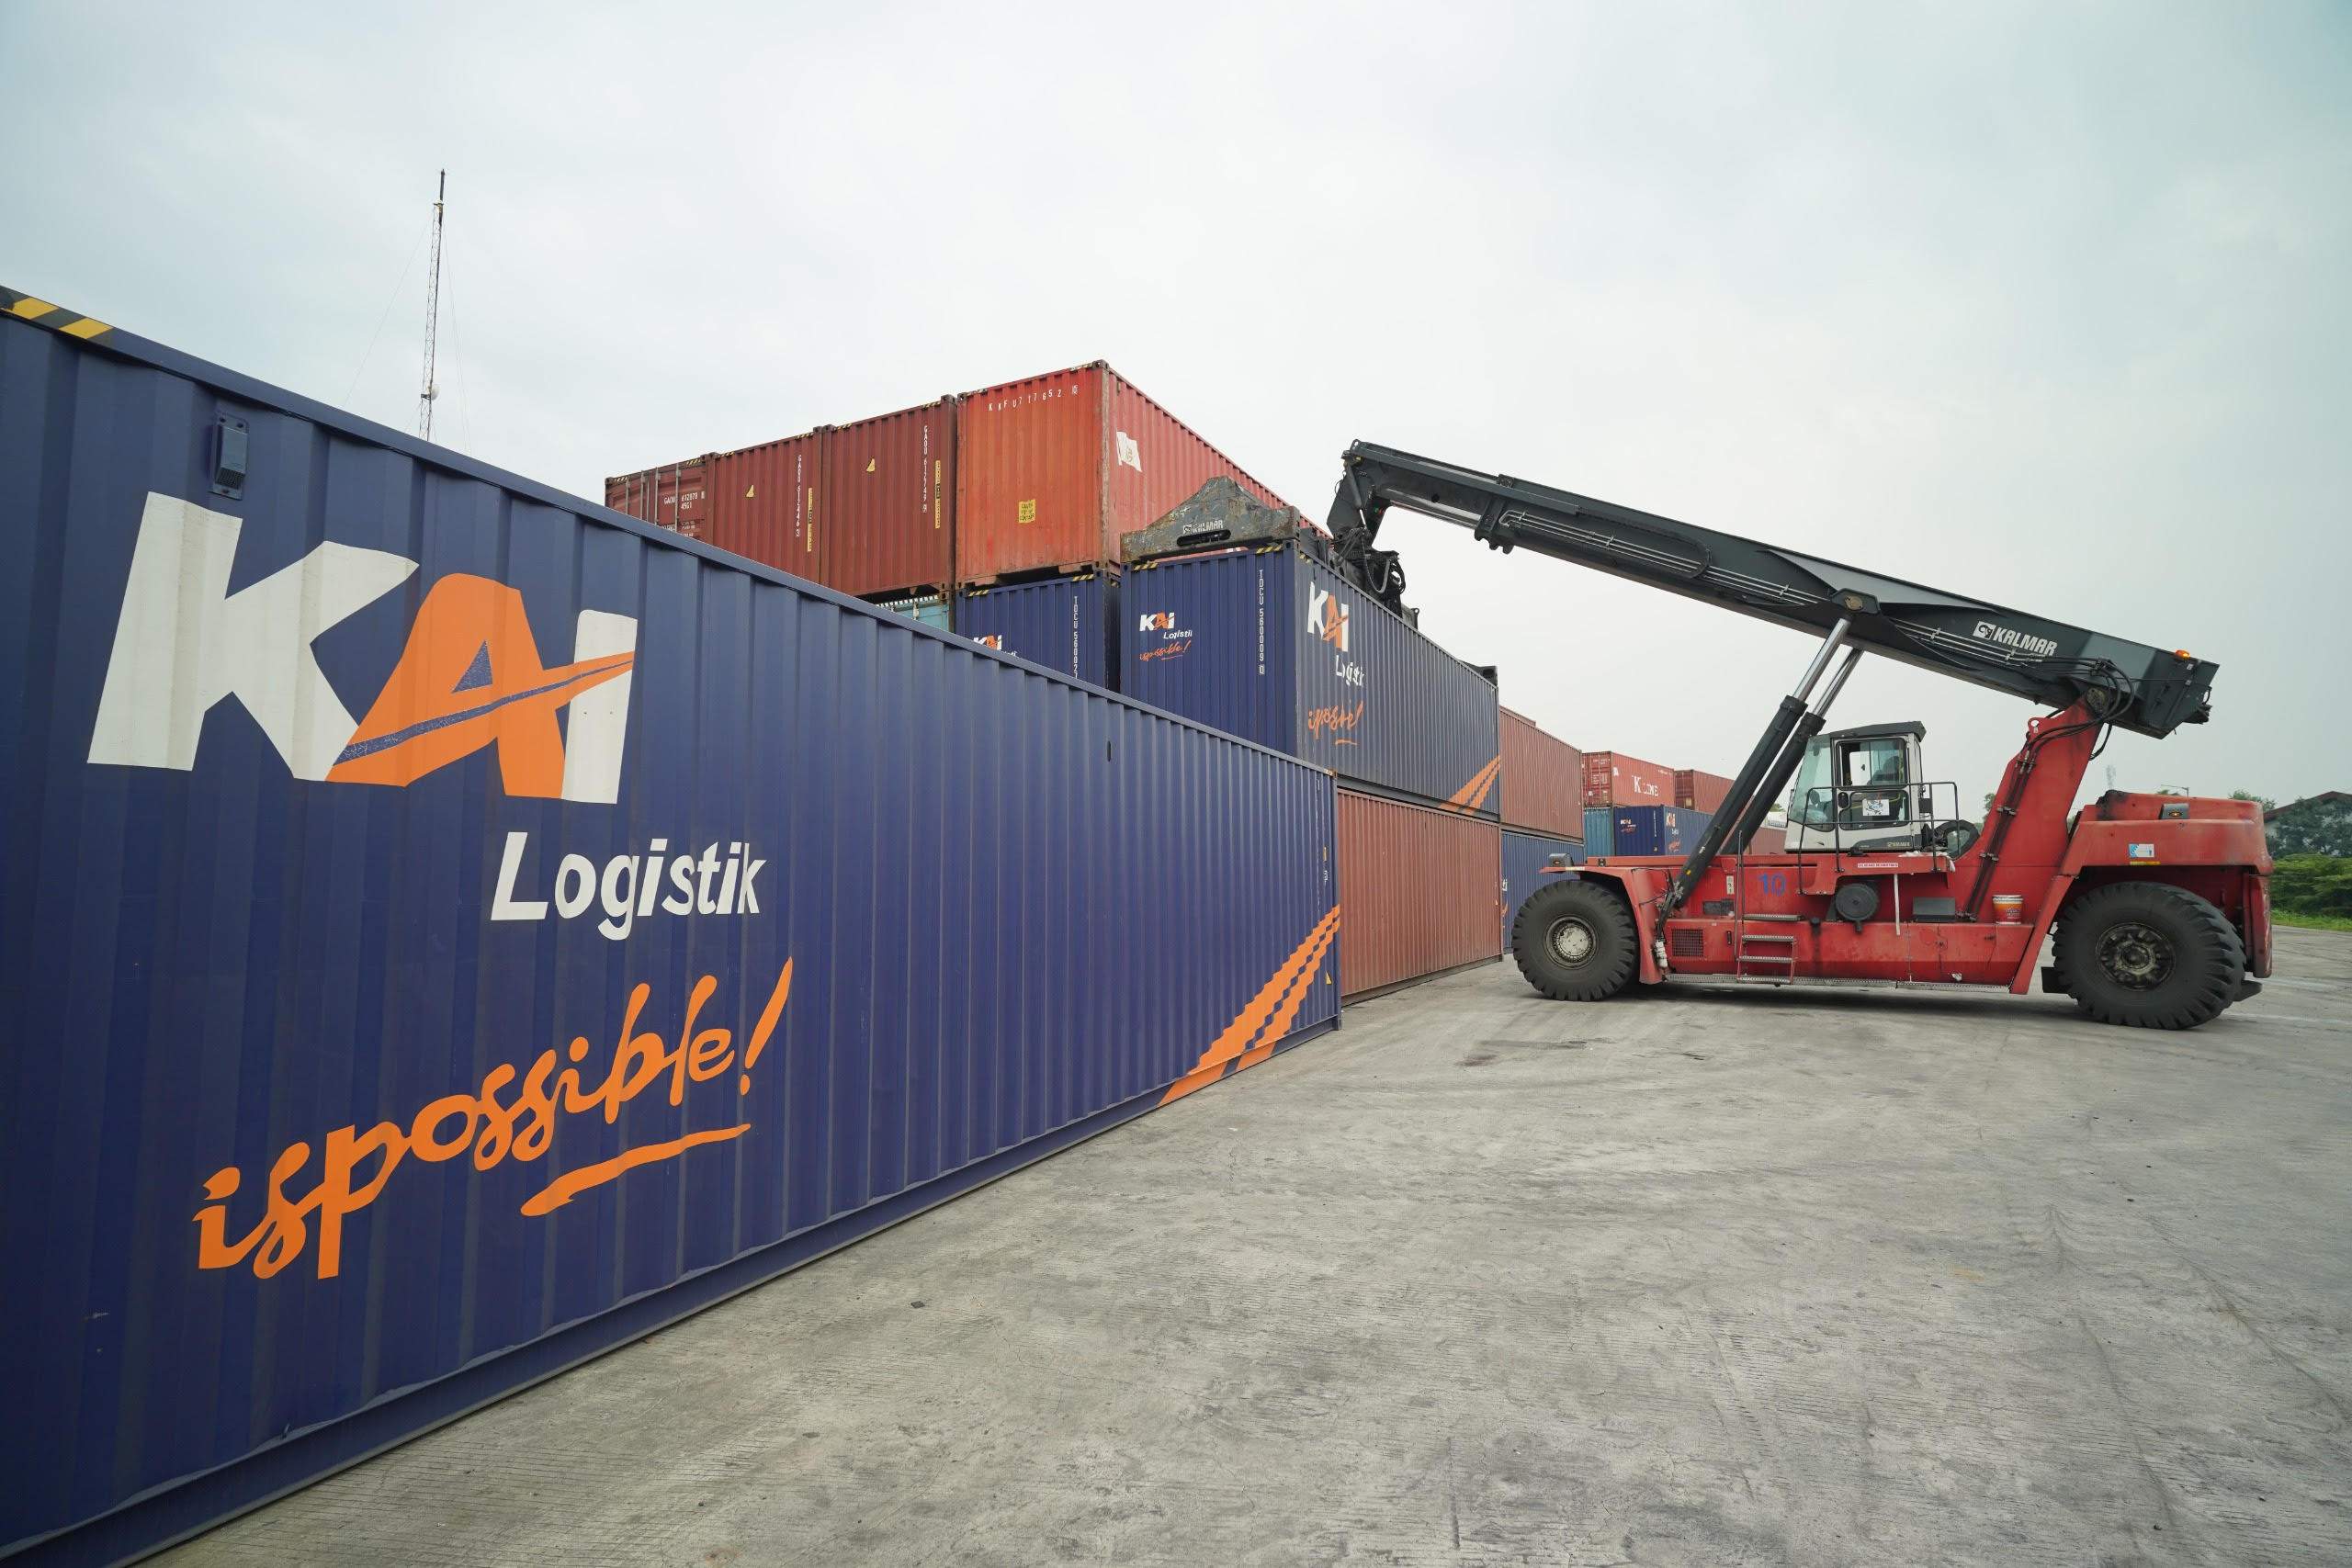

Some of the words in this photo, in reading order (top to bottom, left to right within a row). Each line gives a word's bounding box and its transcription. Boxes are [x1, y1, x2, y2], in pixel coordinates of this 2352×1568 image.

[1139, 612, 1175, 632] KAI
[1307, 581, 1349, 652] KAI
[1992, 626, 2058, 657] KALMAR
[87, 491, 639, 805] KAI
[490, 831, 768, 941] Logistik
[1758, 874, 1786, 896] 10
